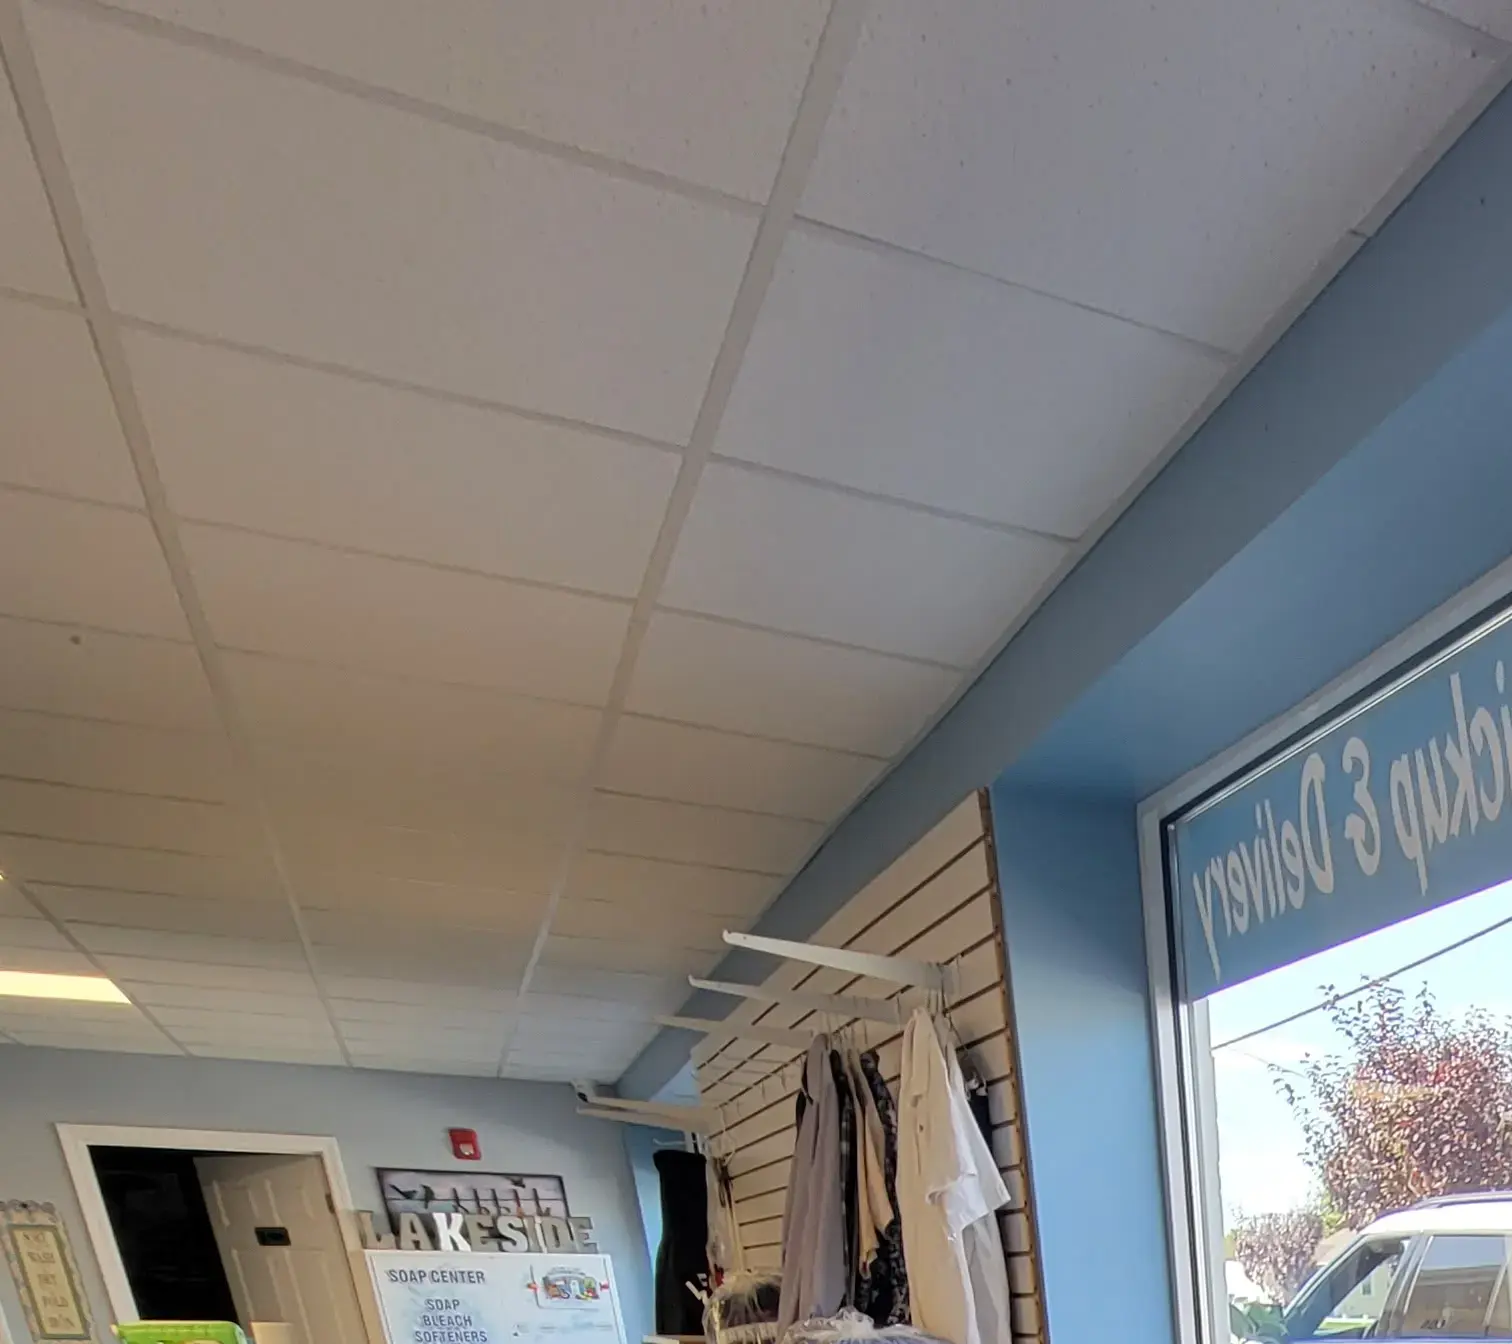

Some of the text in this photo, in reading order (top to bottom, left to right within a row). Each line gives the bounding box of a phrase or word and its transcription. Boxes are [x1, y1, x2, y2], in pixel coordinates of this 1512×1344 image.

[357, 1209, 599, 1254] LAKESIDE
[388, 1269, 486, 1285] SOAP CENTER
[426, 1298, 461, 1312] SOAP
[422, 1315, 473, 1328] BLEACH
[414, 1330, 488, 1344] SOFTENERS
